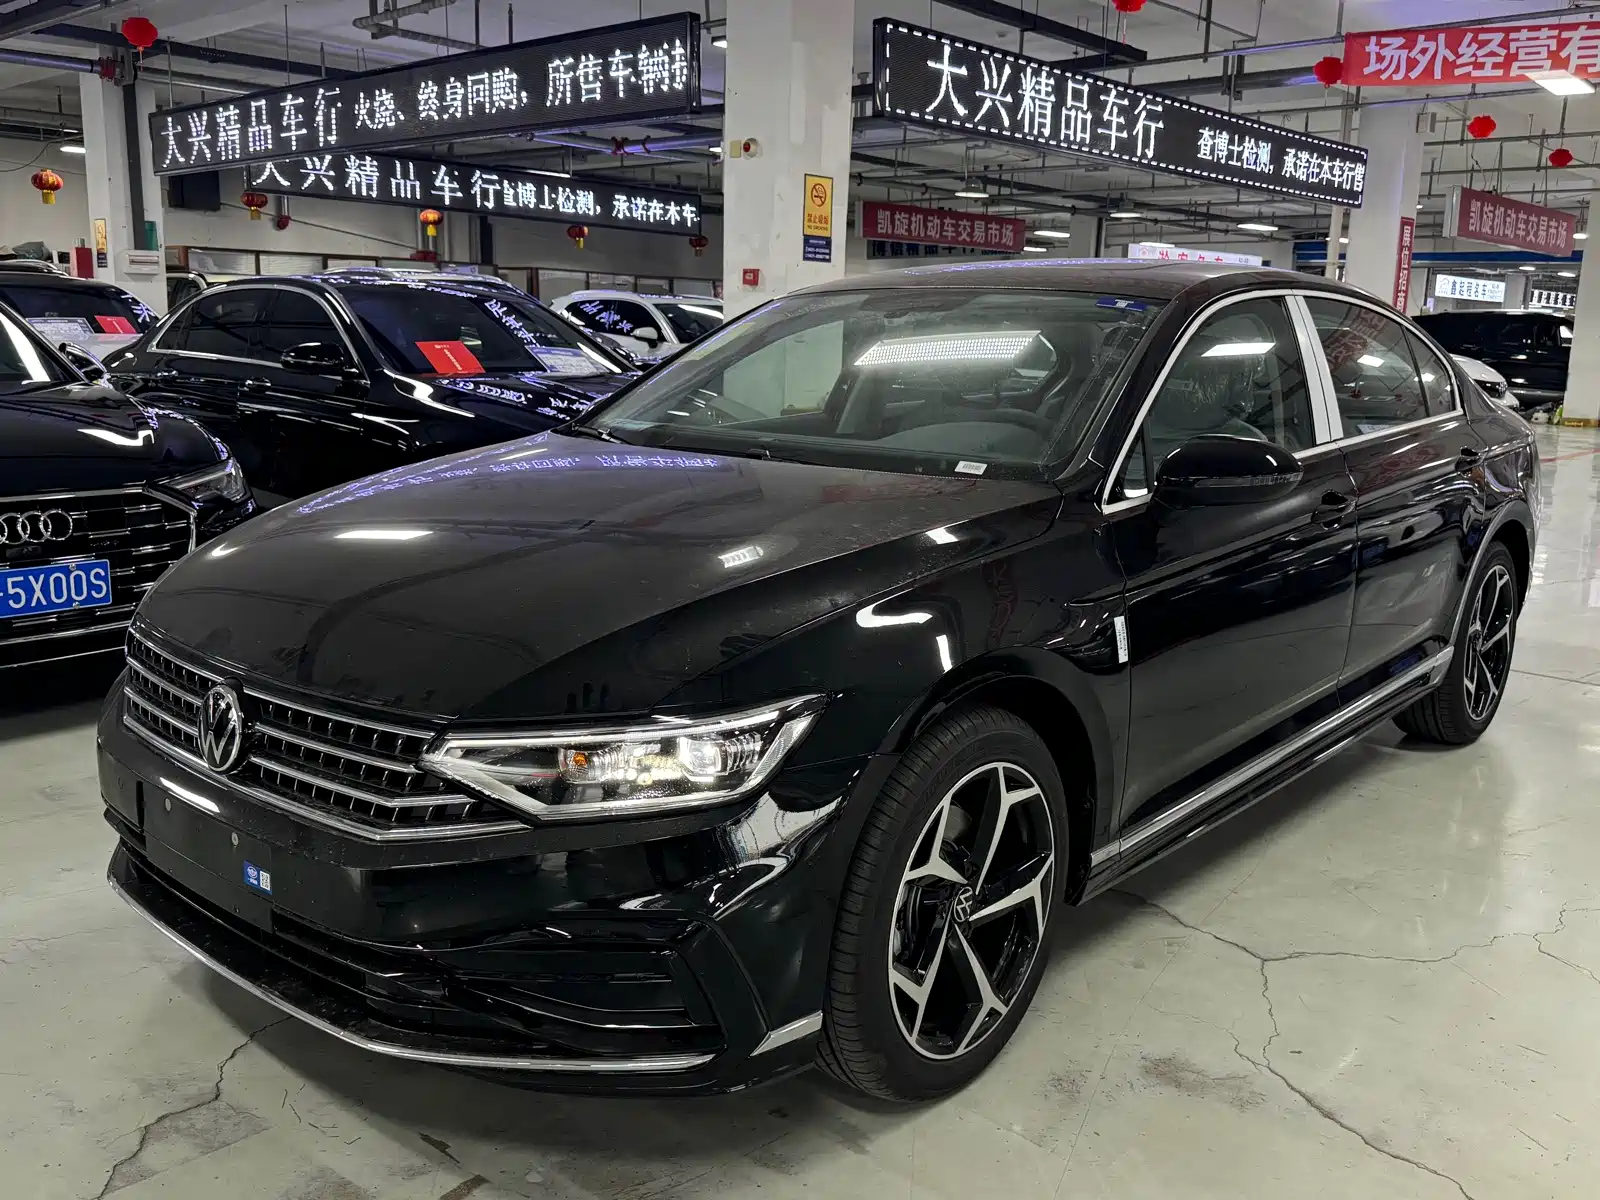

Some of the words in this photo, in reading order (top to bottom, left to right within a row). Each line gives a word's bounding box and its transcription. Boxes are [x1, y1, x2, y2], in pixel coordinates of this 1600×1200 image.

[1363, 25, 1600, 81] 场外经营有
[161, 88, 342, 168] 大兴精品车行
[925, 44, 1164, 159] 大兴精品车行
[877, 209, 1014, 247] 凯旋机动车交易市场
[1468, 199, 1568, 248] 凯旋机动车交易市场
